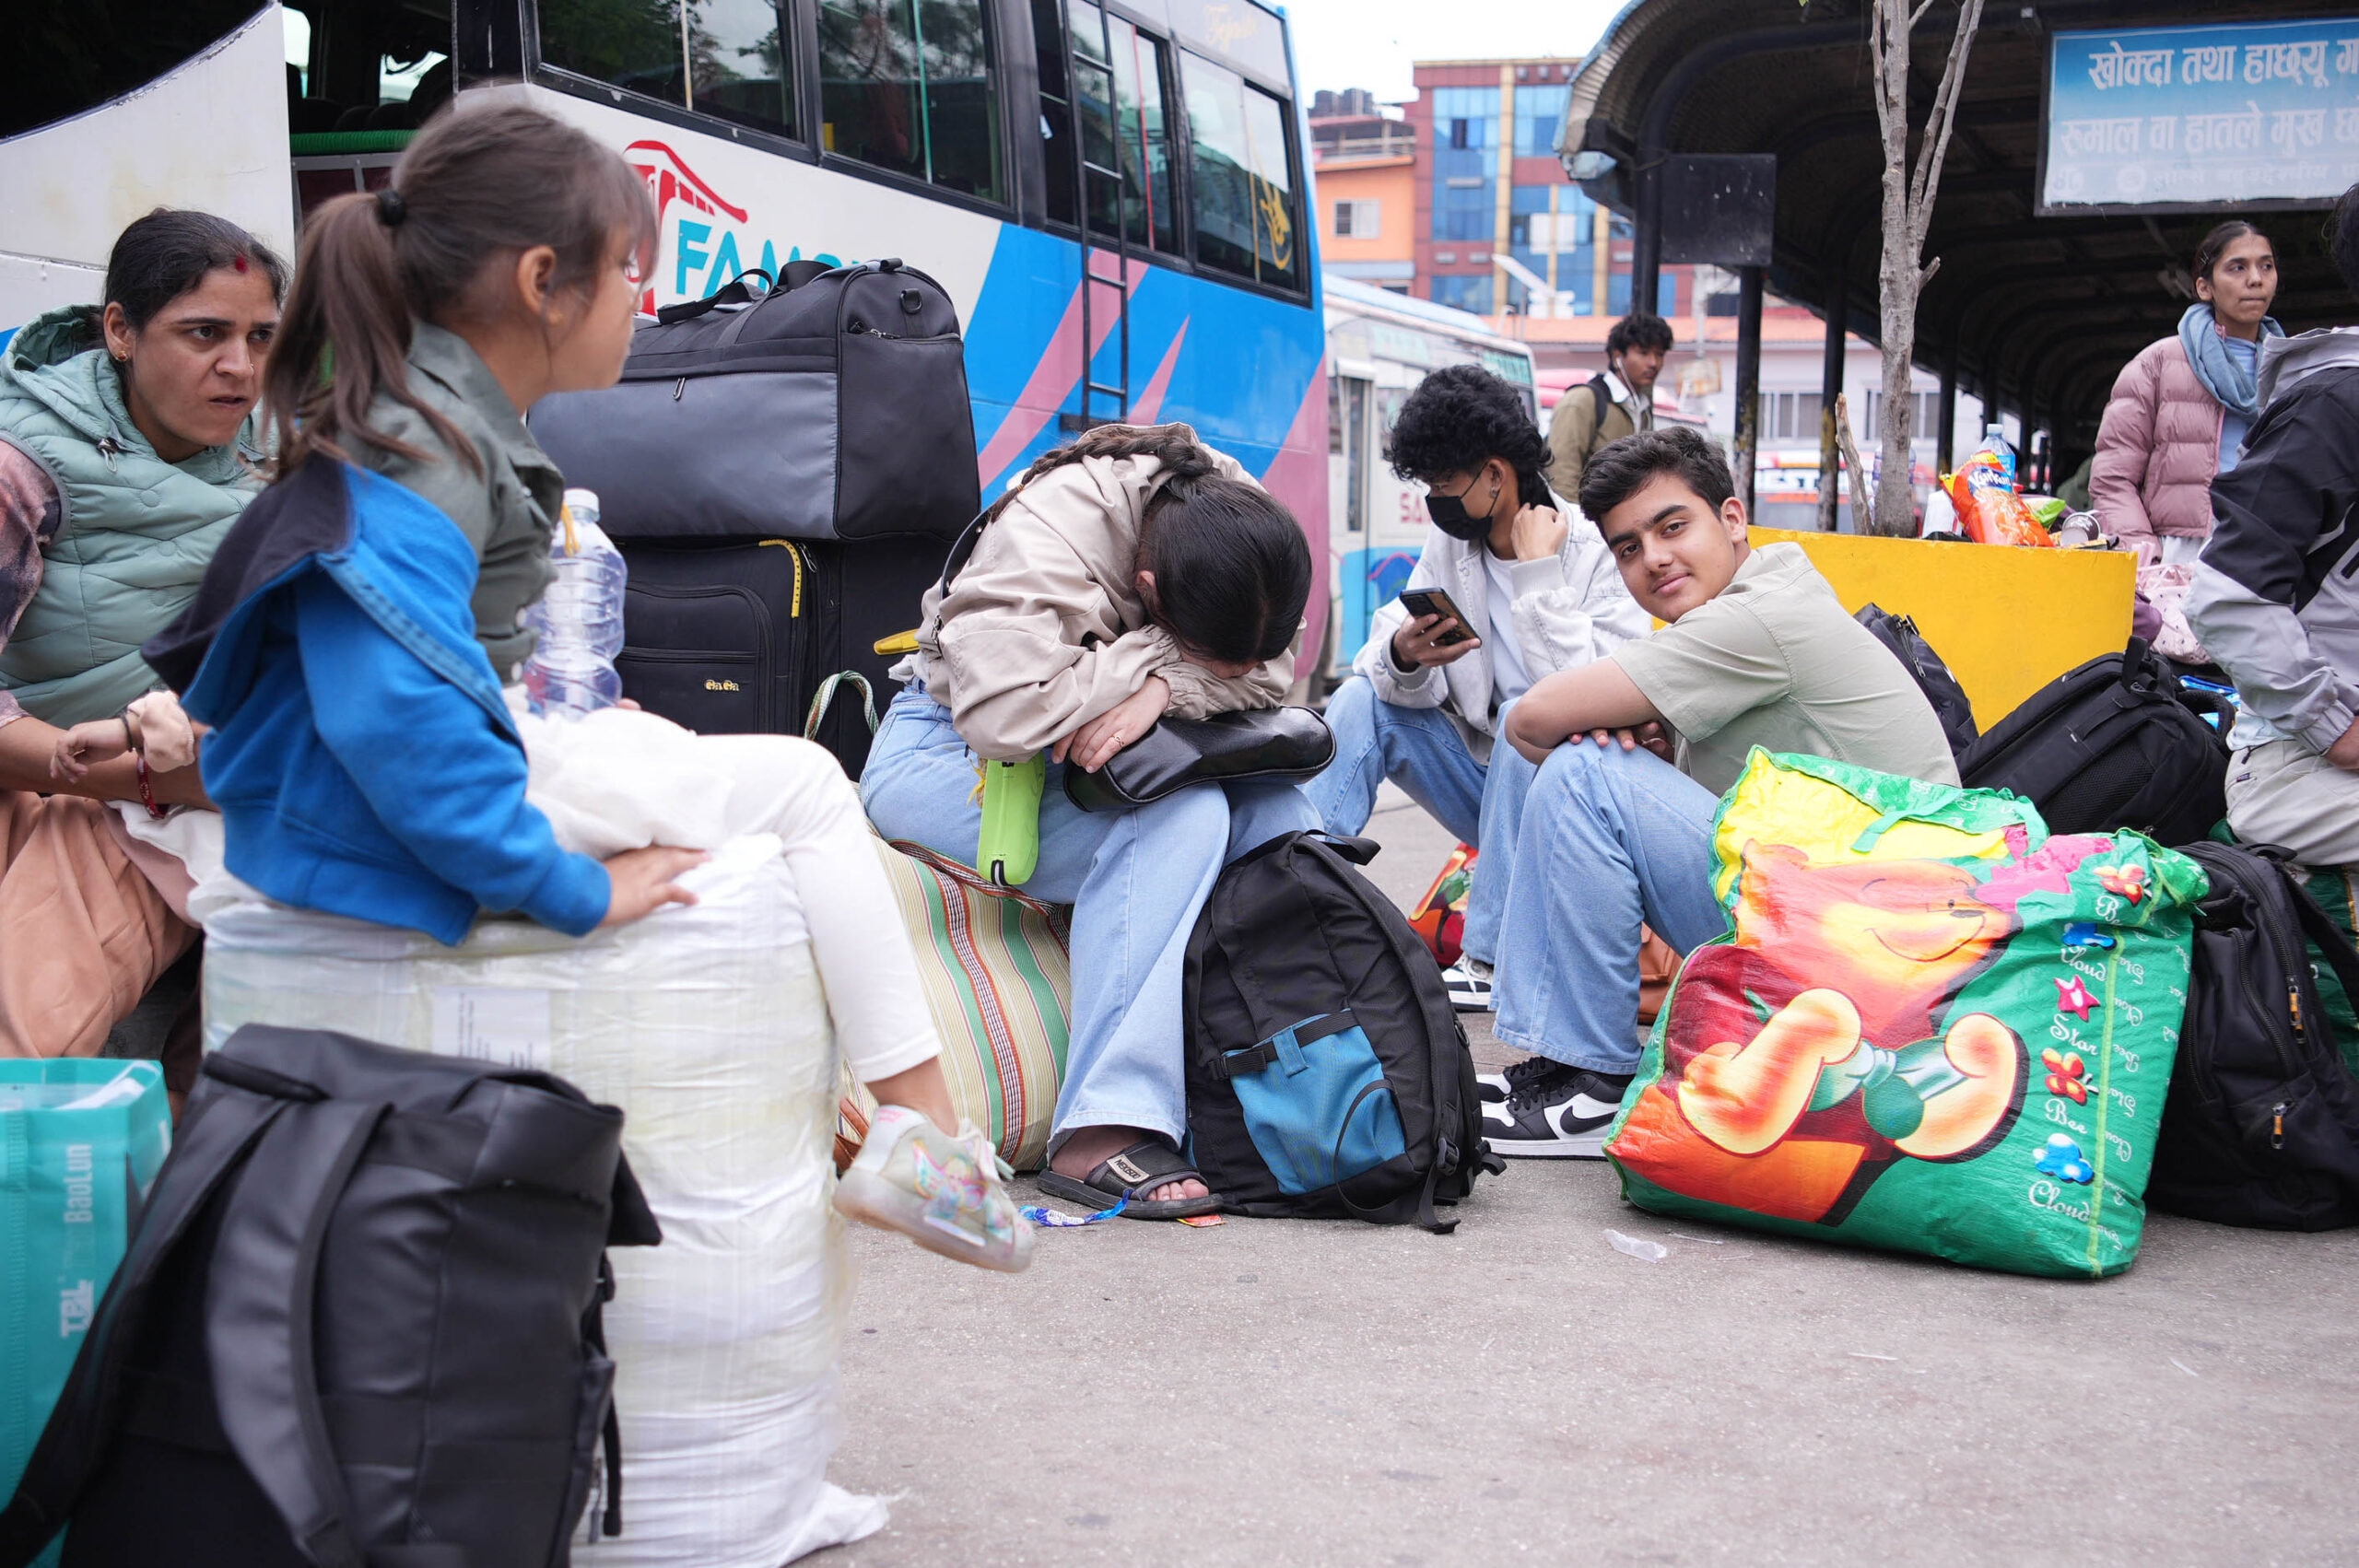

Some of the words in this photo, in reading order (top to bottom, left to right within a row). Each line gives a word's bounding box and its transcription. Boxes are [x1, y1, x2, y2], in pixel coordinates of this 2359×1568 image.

[2182, 45, 2237, 85] तथा
[2150, 116, 2178, 151] वा
[2185, 100, 2264, 154] हातले
[2270, 109, 2328, 158] मुख
[705, 679, 740, 692] GaGa
[2049, 1013, 2098, 1057] Star
[2045, 1099, 2088, 1135] Bee
[64, 1143, 93, 1224] BaoLun
[2029, 1180, 2091, 1223] Cloud
